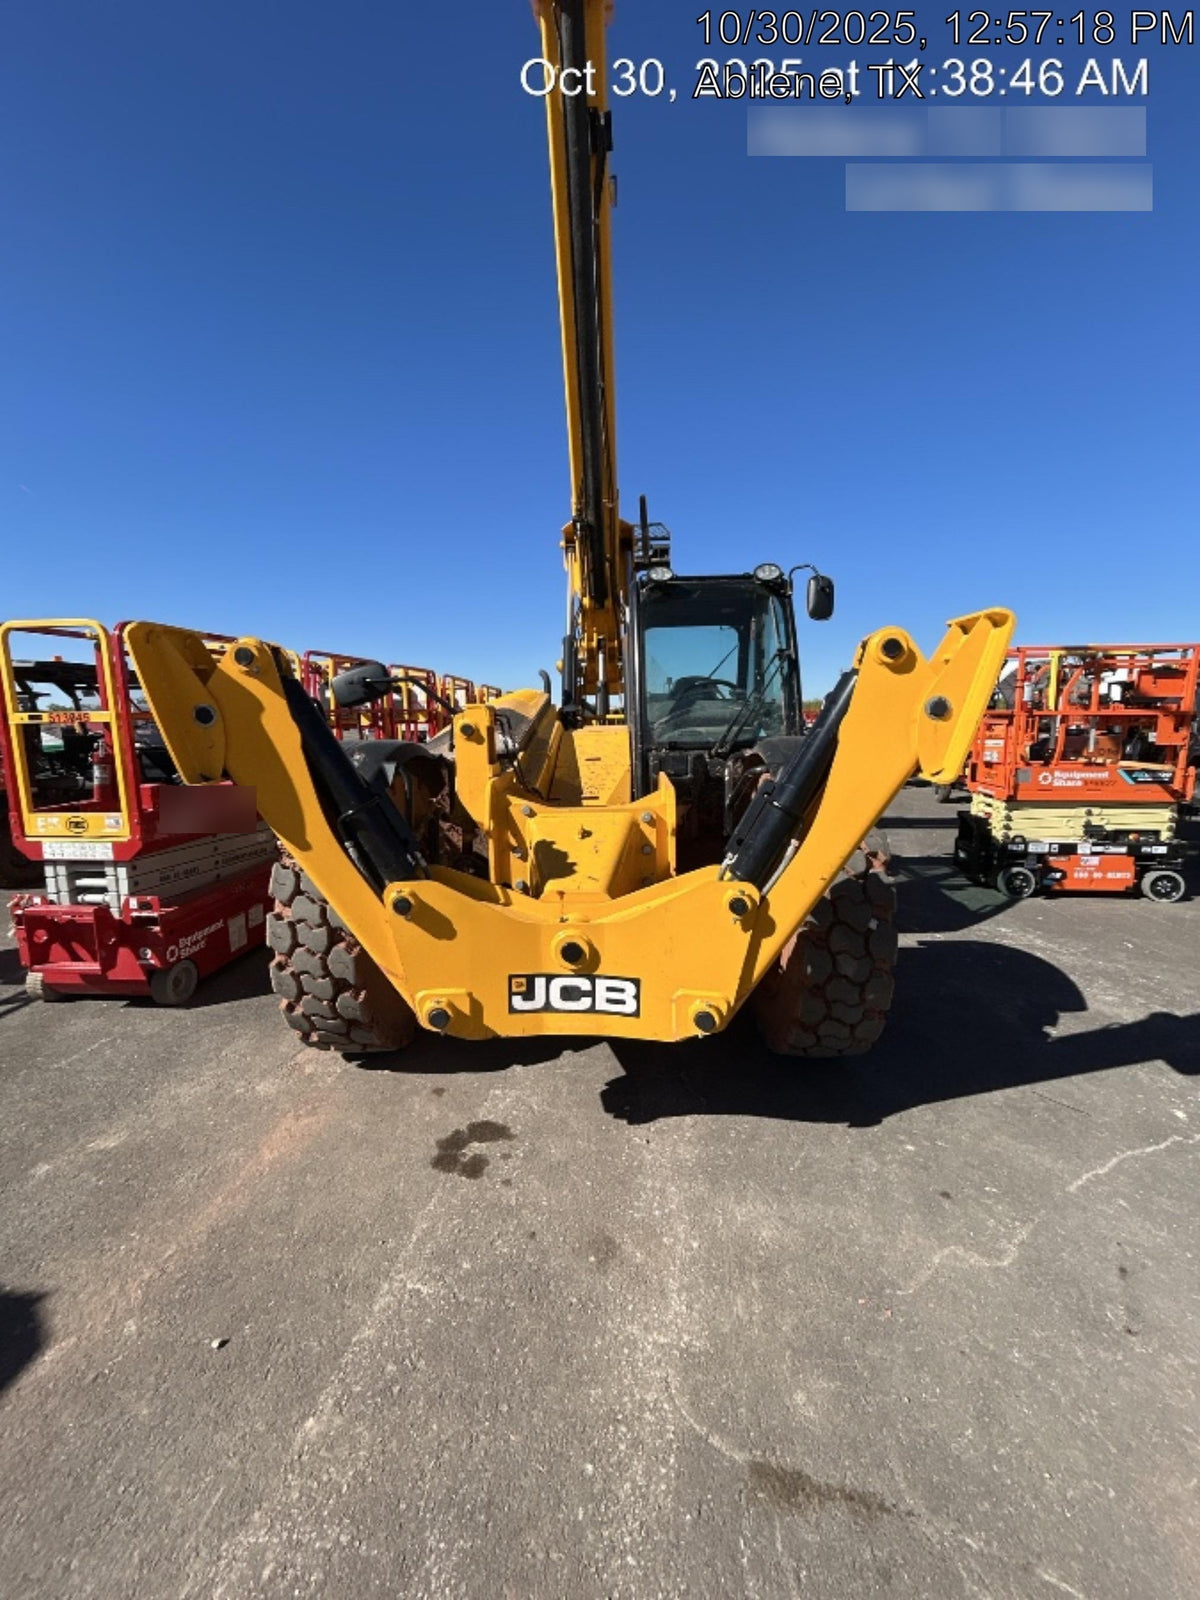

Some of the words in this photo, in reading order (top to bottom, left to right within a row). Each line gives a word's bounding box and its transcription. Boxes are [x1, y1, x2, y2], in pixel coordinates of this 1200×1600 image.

[1053, 770, 1110, 780] Equipment
[1052, 778, 1083, 787] Share
[511, 976, 638, 1014] JCB
